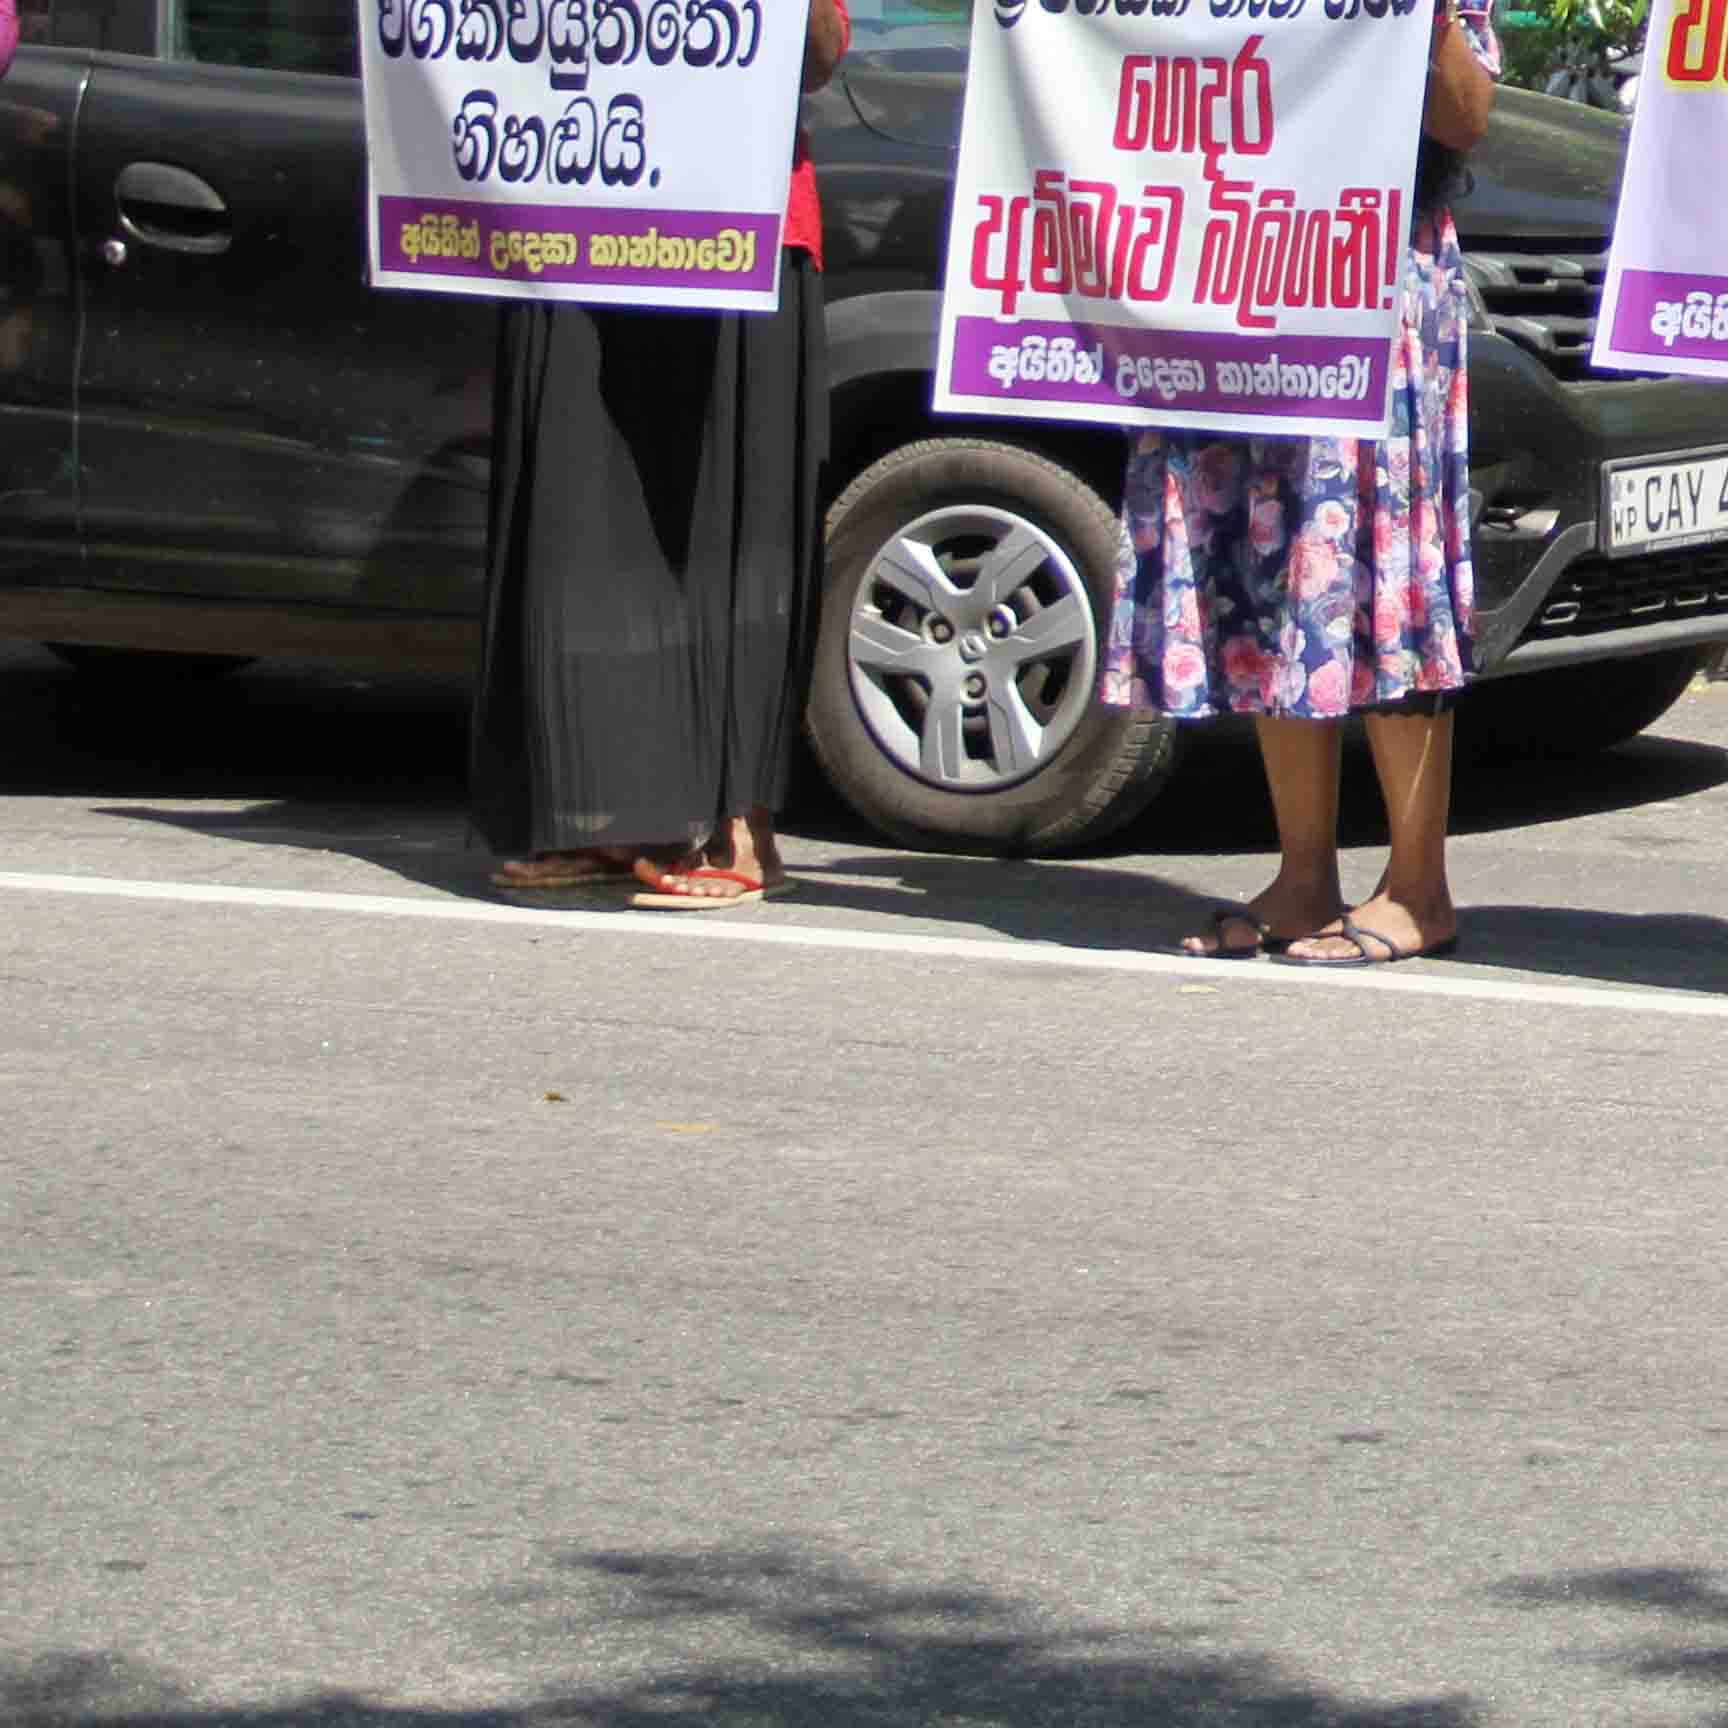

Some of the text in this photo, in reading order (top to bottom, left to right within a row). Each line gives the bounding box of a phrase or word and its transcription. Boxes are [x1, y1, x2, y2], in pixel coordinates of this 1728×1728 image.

[454, 89, 661, 187] නිහඬයි.
[1112, 34, 1274, 180] ගෙදර
[490, 233, 577, 273] උදෙසා
[588, 228, 756, 272] කාන්තාවෝ
[970, 170, 1185, 315] අම්මාව
[1116, 357, 1206, 401] උදෙසා
[1215, 356, 1370, 401] කාන්තාවෝ
[1645, 468, 1704, 532] CAY
